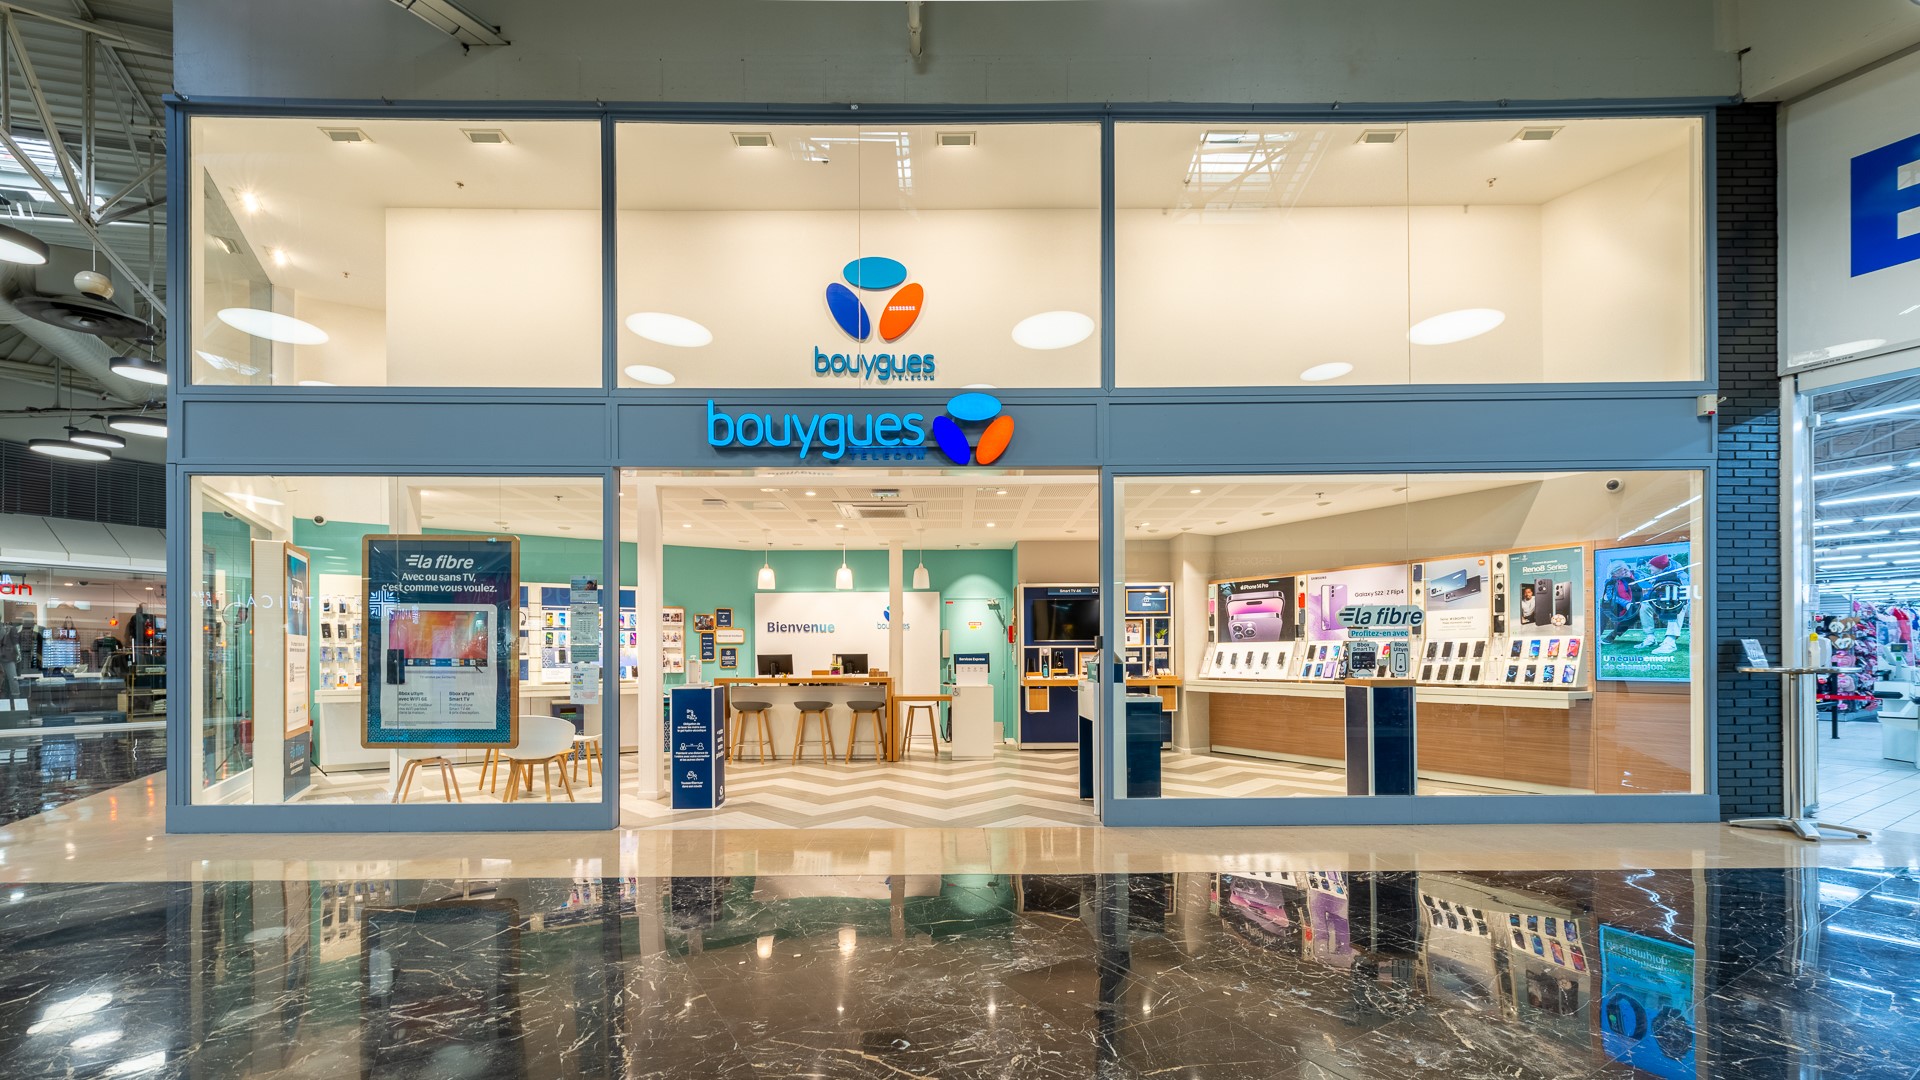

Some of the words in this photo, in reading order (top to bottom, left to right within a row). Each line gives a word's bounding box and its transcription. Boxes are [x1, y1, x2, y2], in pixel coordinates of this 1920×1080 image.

[814, 346, 935, 381] bouygues
[707, 399, 926, 460] bouygues
[418, 555, 433, 568] la
[435, 554, 474, 569] fibre
[402, 572, 424, 581] Avec
[463, 573, 476, 583] TV,
[382, 583, 403, 592] c'est
[464, 584, 498, 592] voulez.
[1354, 608, 1372, 624] la
[1376, 608, 1422, 625] fibre
[767, 622, 835, 633] Bienvenue
[1617, 654, 1675, 663] équipement
[1616, 663, 1667, 671] champion.
